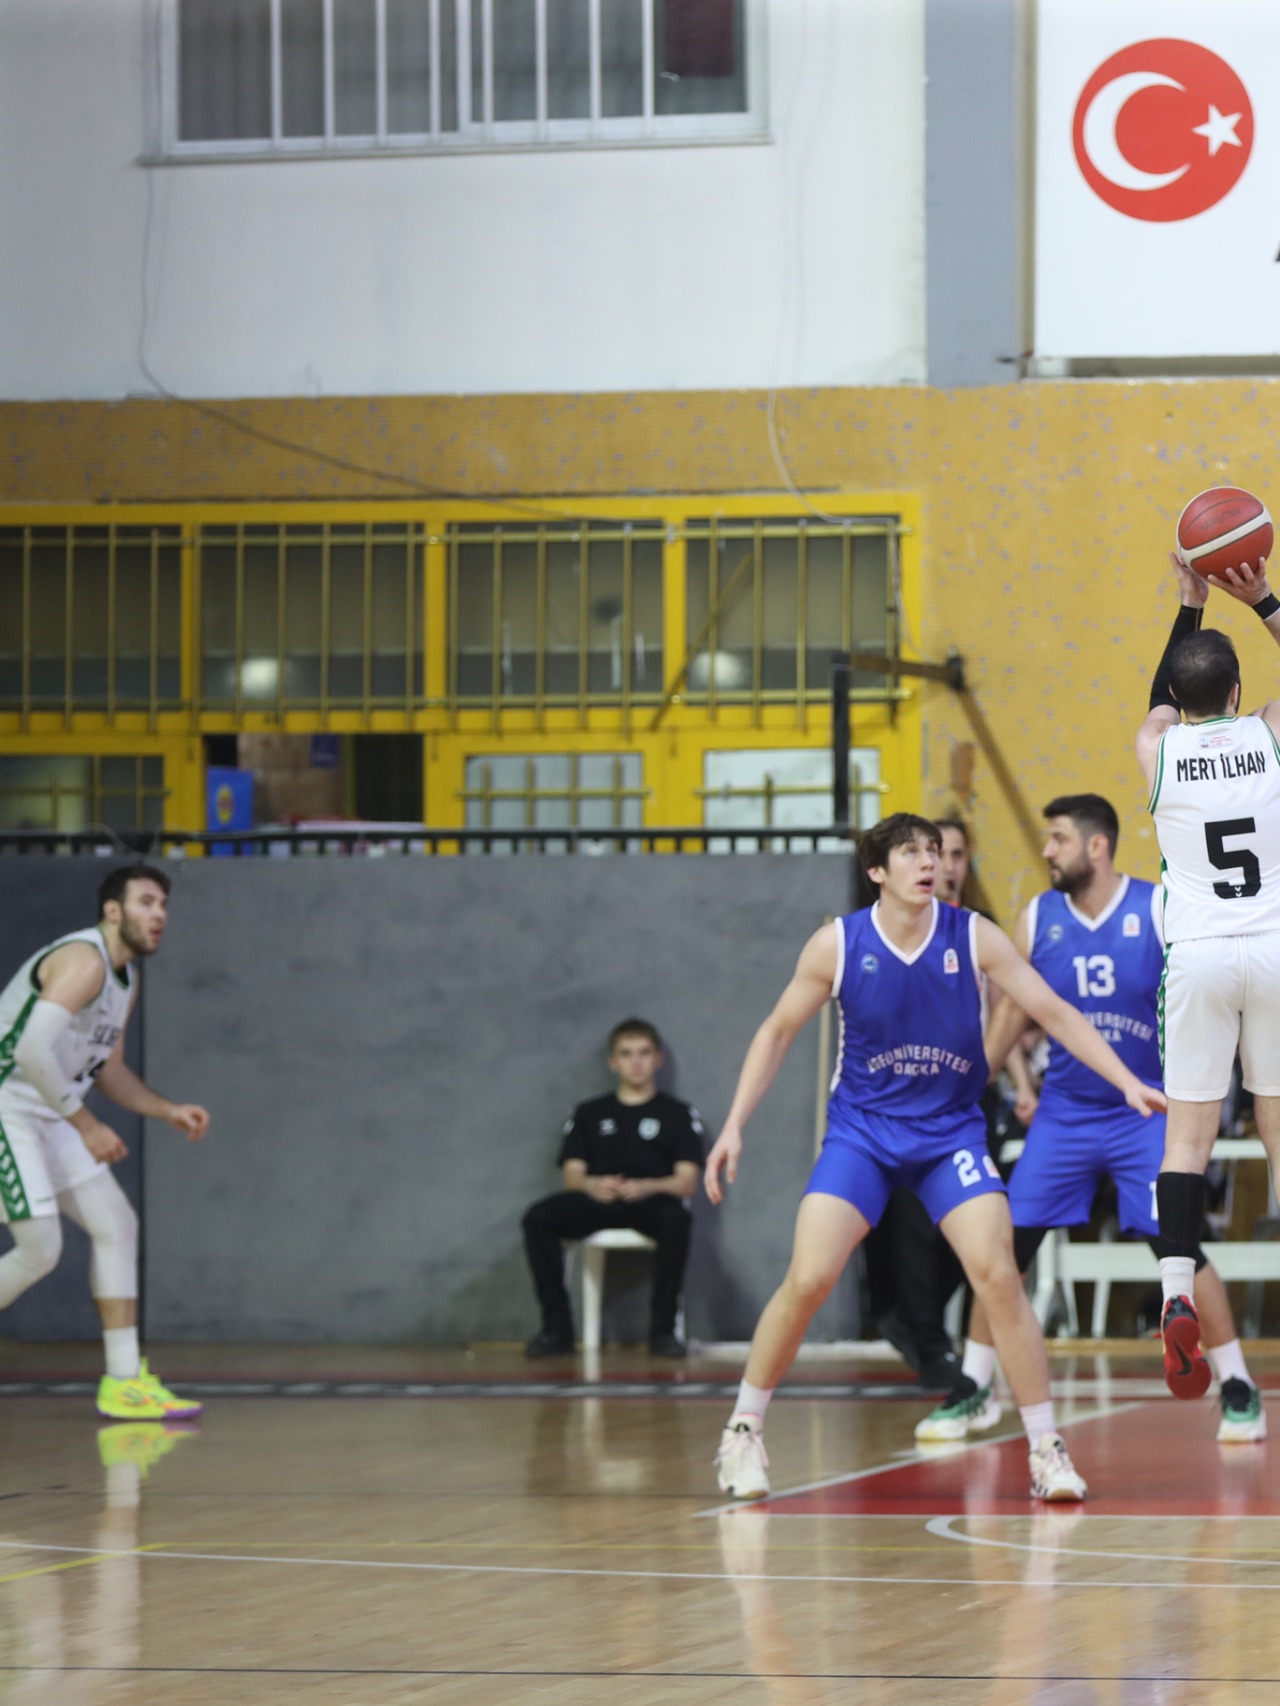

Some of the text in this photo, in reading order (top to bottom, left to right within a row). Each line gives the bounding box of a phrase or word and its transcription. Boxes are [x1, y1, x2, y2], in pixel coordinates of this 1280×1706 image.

[1177, 758, 1216, 782] MERT
[1204, 817, 1261, 899] 5
[1073, 955, 1116, 998] 13
[953, 1149, 982, 1188] 2
